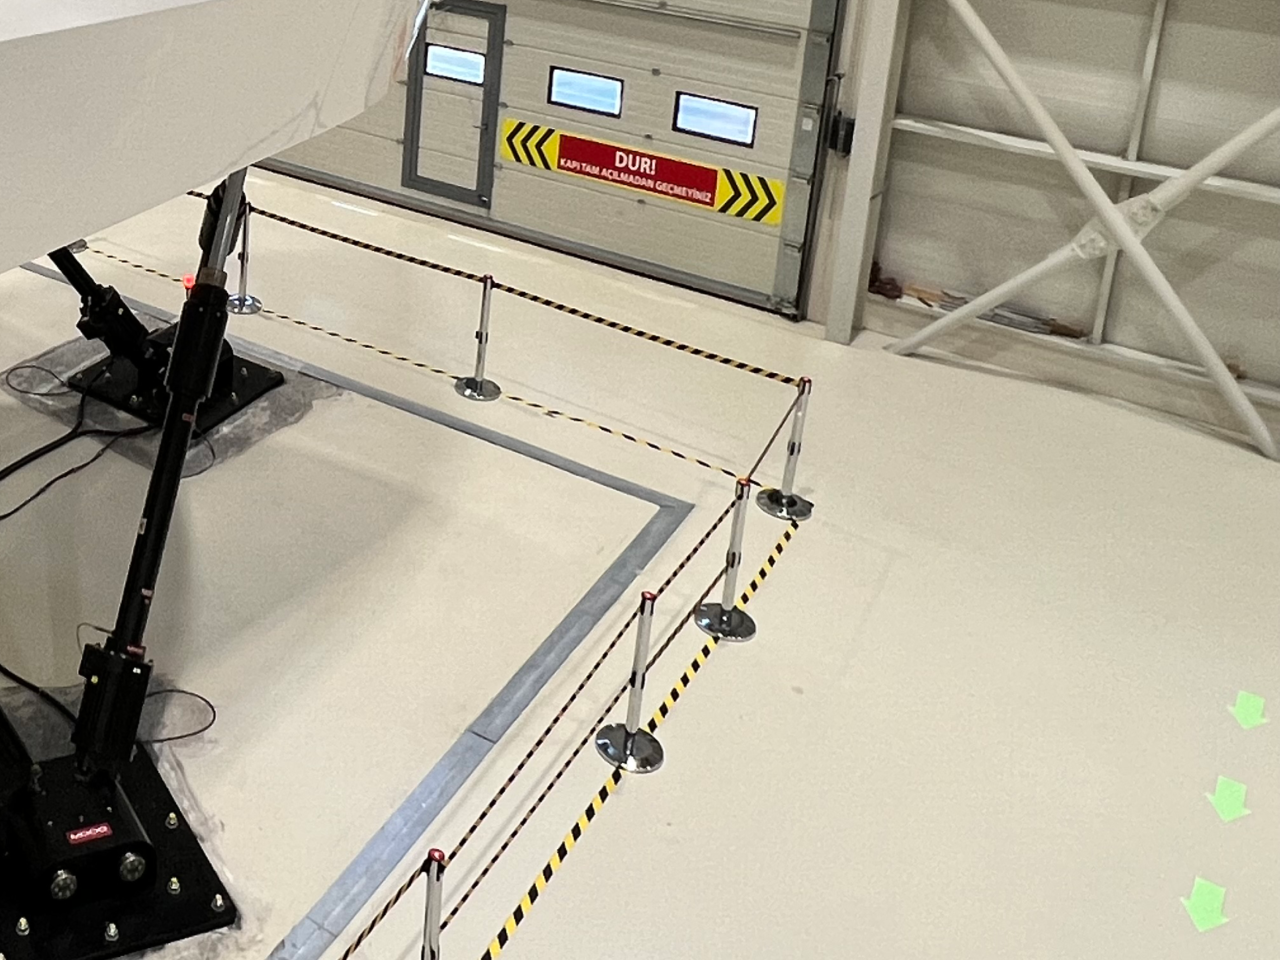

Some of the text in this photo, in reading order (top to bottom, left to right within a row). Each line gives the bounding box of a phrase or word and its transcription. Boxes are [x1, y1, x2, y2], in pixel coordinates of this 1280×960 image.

[560, 158, 581, 170] KAPI
[581, 163, 601, 176] TAM
[601, 167, 654, 189] AÇILMADAN
[614, 151, 656, 175] DUR!
